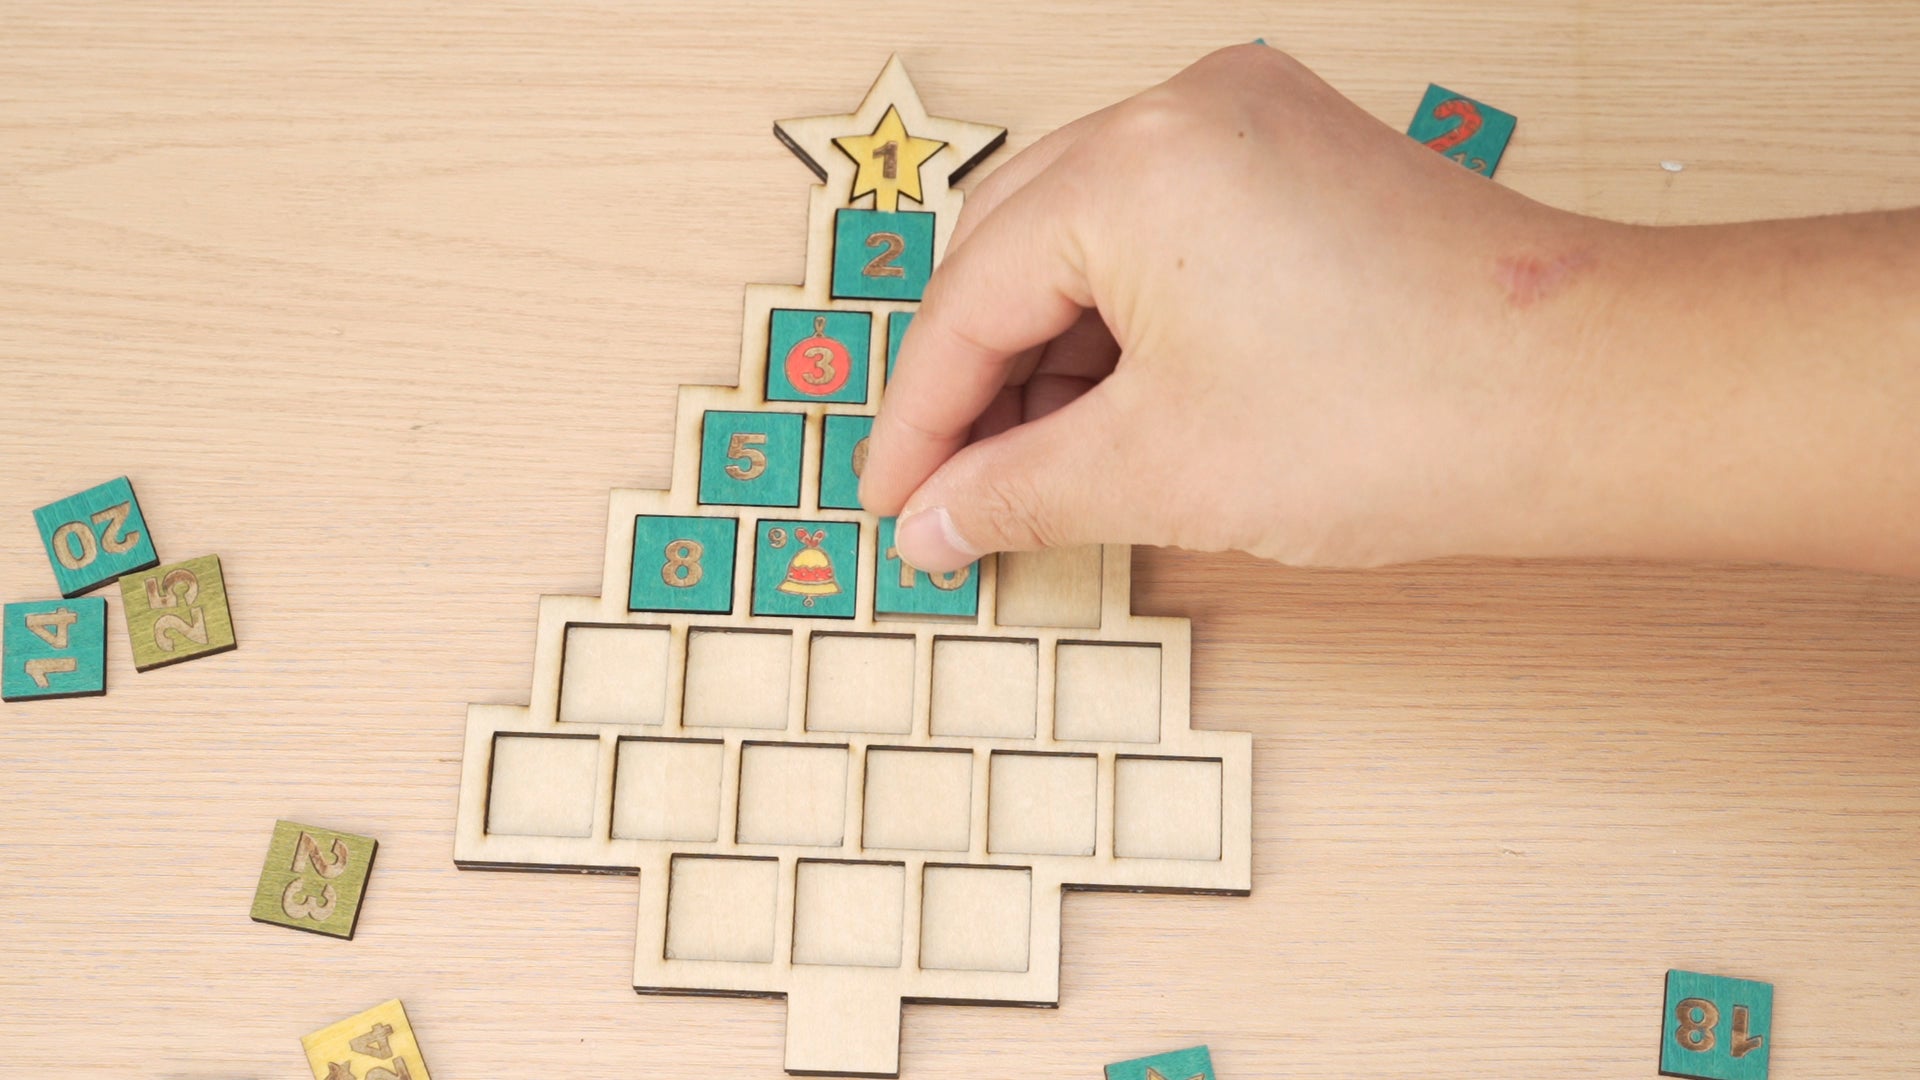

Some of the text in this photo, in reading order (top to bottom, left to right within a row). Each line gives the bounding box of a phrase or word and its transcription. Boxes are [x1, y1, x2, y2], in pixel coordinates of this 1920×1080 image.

[872, 140, 899, 180] 1
[862, 231, 905, 279] 2
[801, 346, 837, 386] 3
[724, 432, 767, 482] 5
[51, 500, 141, 571] 20
[767, 527, 788, 549] 9
[660, 538, 704, 588] 8
[144, 567, 210, 652] 25
[24, 606, 79, 689] 14
[281, 830, 349, 922] 23
[1674, 996, 1764, 1059] 18
